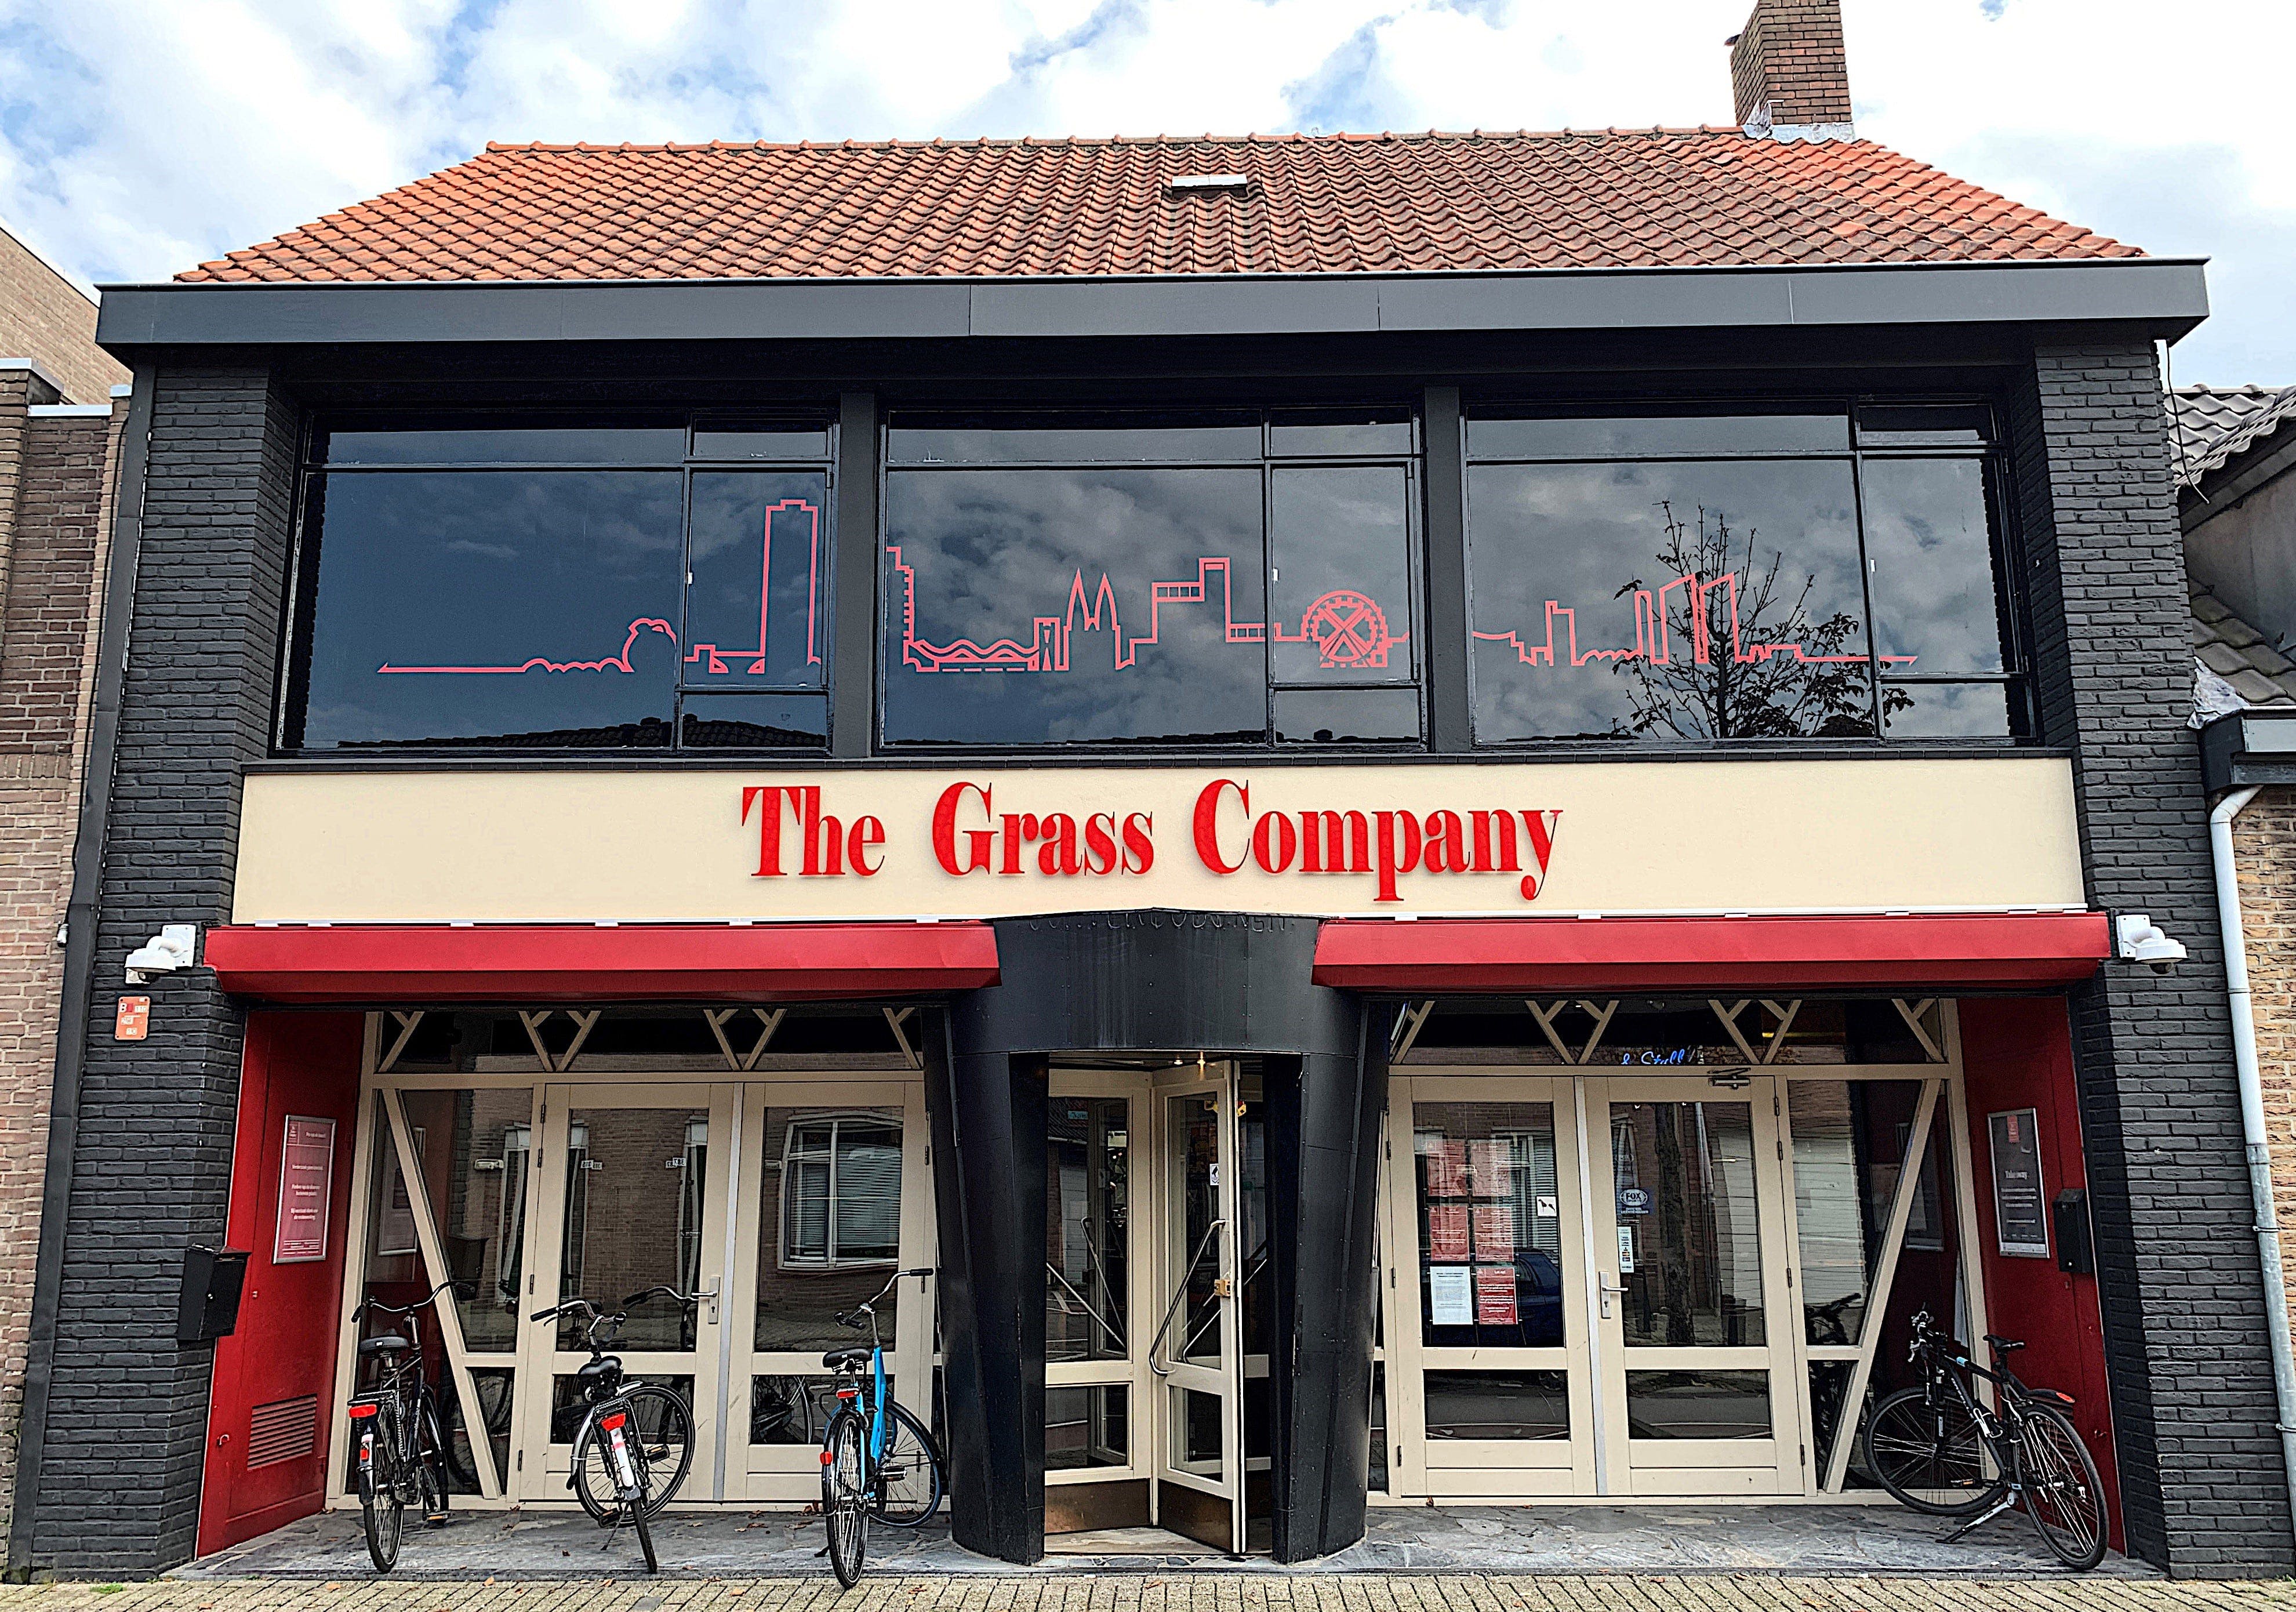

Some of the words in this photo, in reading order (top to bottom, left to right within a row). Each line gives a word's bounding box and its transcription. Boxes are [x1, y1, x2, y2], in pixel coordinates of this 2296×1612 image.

[742, 786, 885, 876] The
[932, 782, 1154, 876] Grass
[1193, 779, 1564, 902] Company
[1626, 1192, 1641, 1201] FOX
